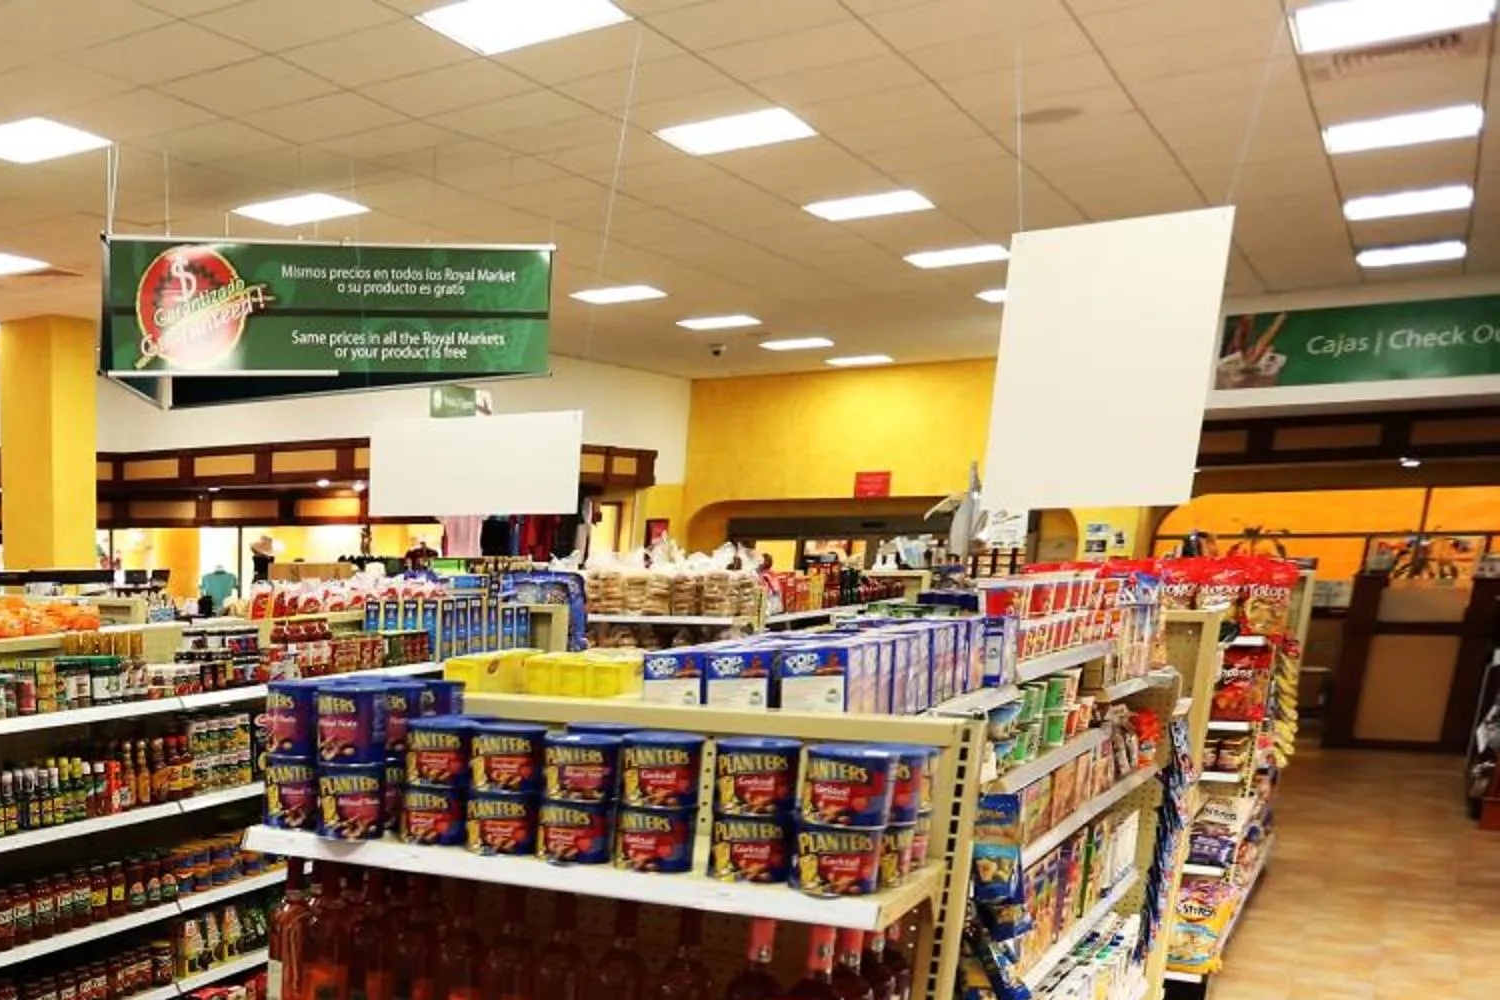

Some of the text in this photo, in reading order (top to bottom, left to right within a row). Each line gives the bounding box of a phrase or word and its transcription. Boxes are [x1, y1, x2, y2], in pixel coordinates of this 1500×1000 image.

[281, 264, 516, 285] Mismos precios en todos los Royal Market
[337, 281, 465, 298] o su producto es gratis
[291, 329, 505, 349] Same prices in all the Royal Markets
[1306, 334, 1369, 357] Cajas
[1389, 325, 1466, 349] Check
[334, 345, 467, 361] or your product is free
[625, 747, 690, 769] PLANTERS
[719, 754, 788, 776] PLANTERS
[715, 821, 784, 842] PLANTERS
[799, 831, 874, 855] PLANTERS
